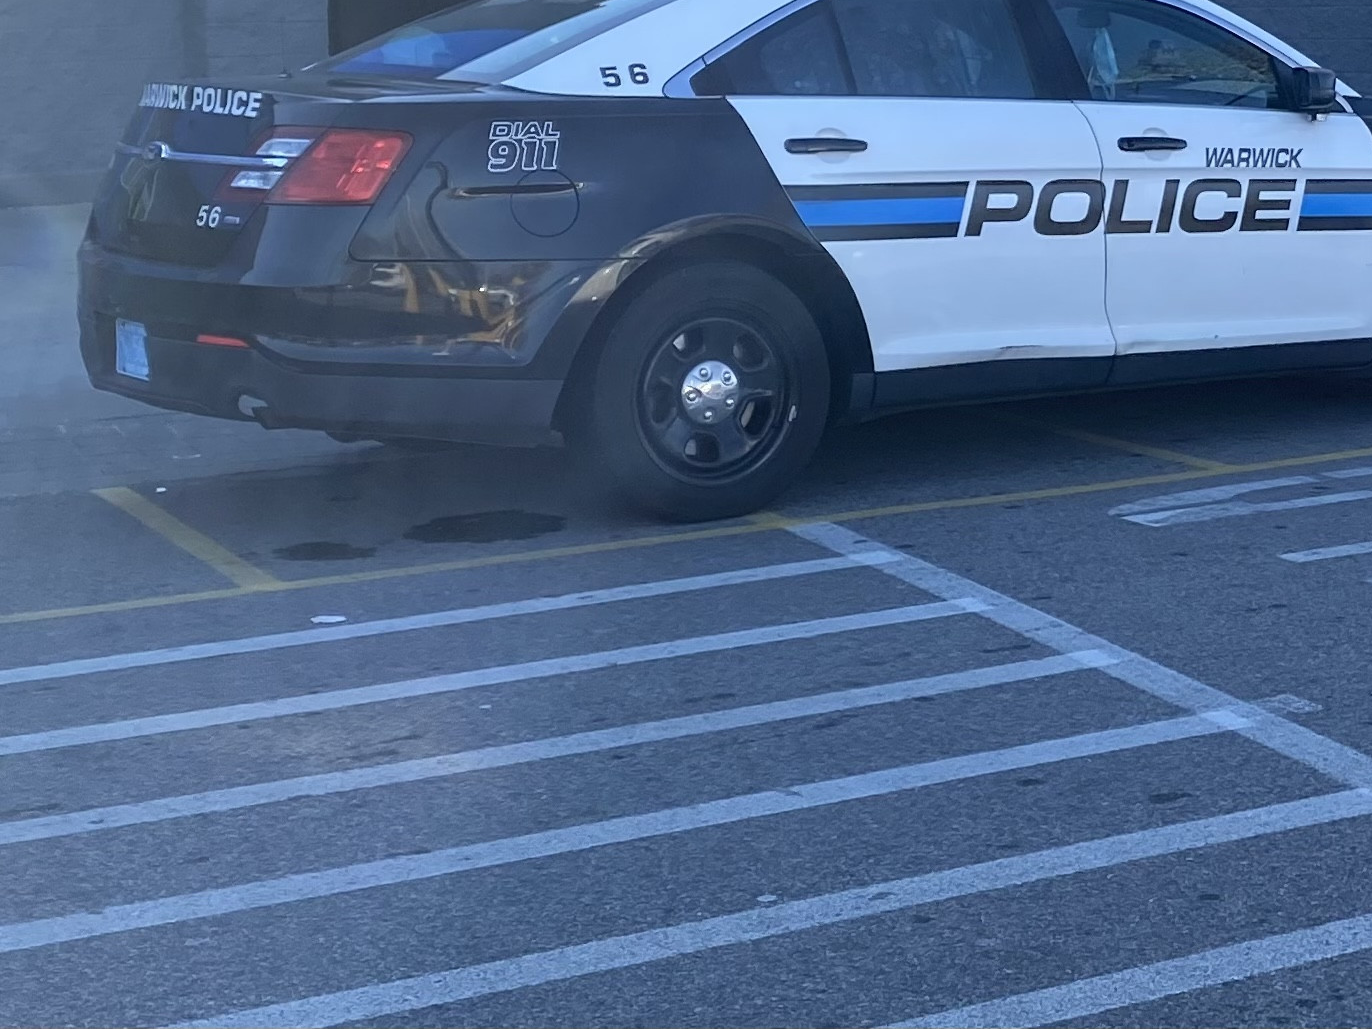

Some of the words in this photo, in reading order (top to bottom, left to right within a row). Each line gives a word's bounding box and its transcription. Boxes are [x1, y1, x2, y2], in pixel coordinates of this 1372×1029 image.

[599, 63, 650, 88] 56
[190, 86, 263, 118] POLICE
[489, 121, 561, 140] DIAL
[487, 138, 560, 172] 911
[1205, 147, 1304, 169] WARWICK
[195, 204, 222, 228] 56
[964, 178, 1297, 237] POLICE
